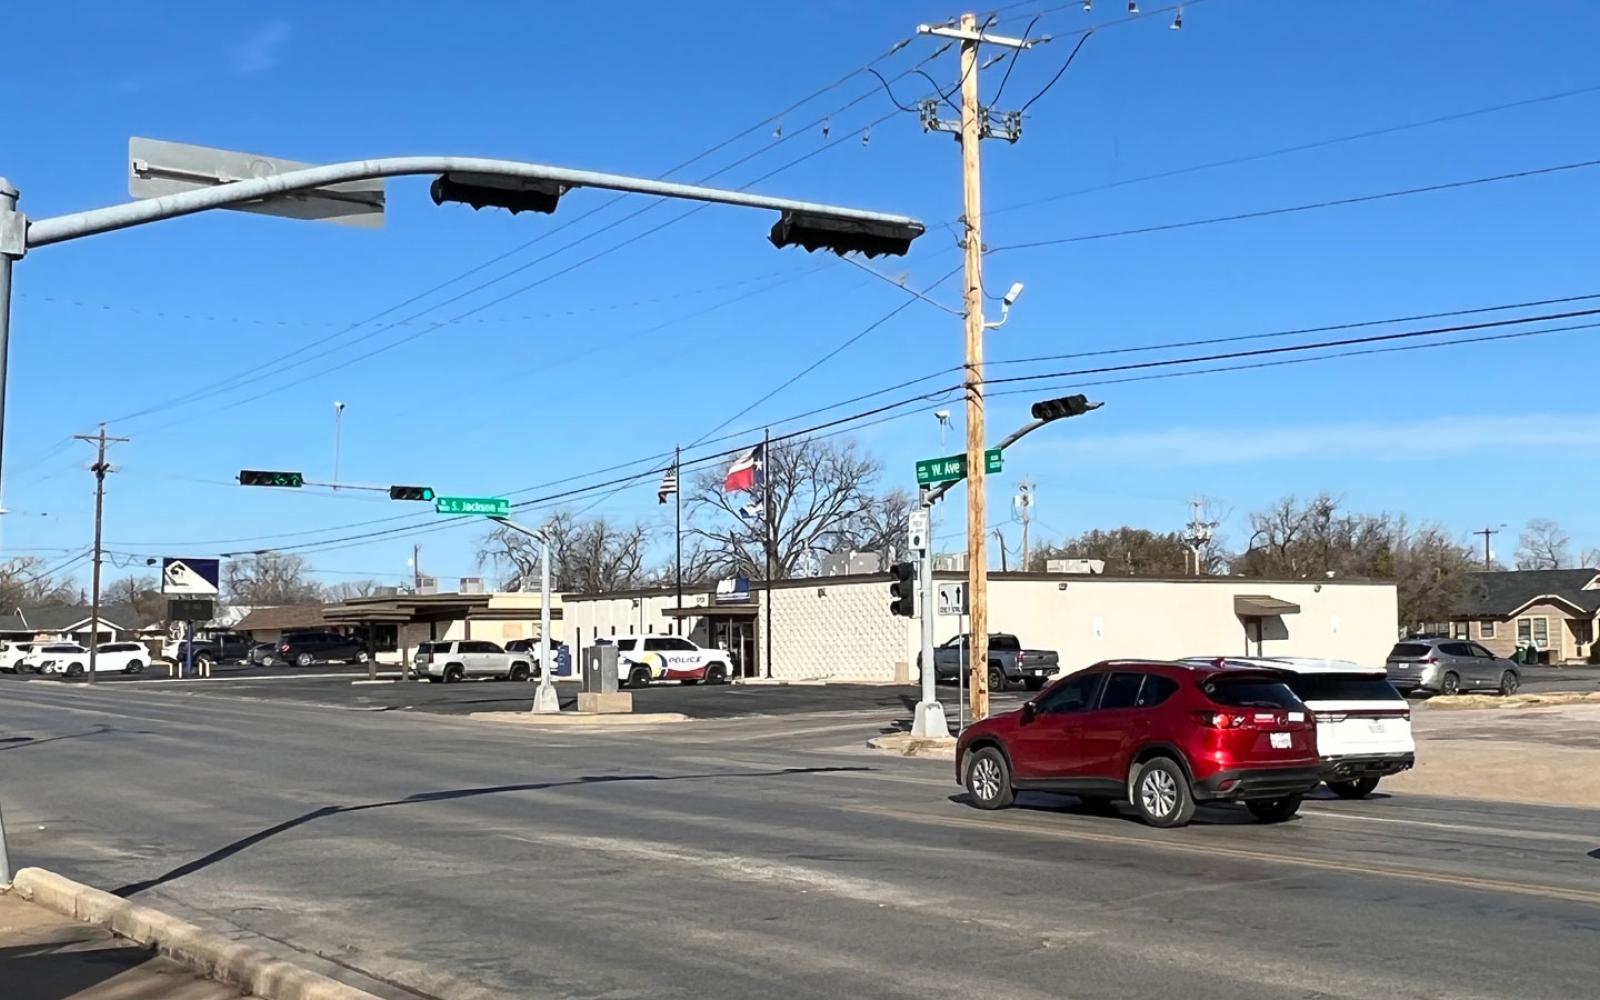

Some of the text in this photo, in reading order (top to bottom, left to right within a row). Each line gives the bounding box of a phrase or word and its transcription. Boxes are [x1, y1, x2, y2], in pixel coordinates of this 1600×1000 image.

[931, 463, 943, 477] W.
[944, 461, 960, 476] Ave
[462, 501, 496, 512] Jackson
